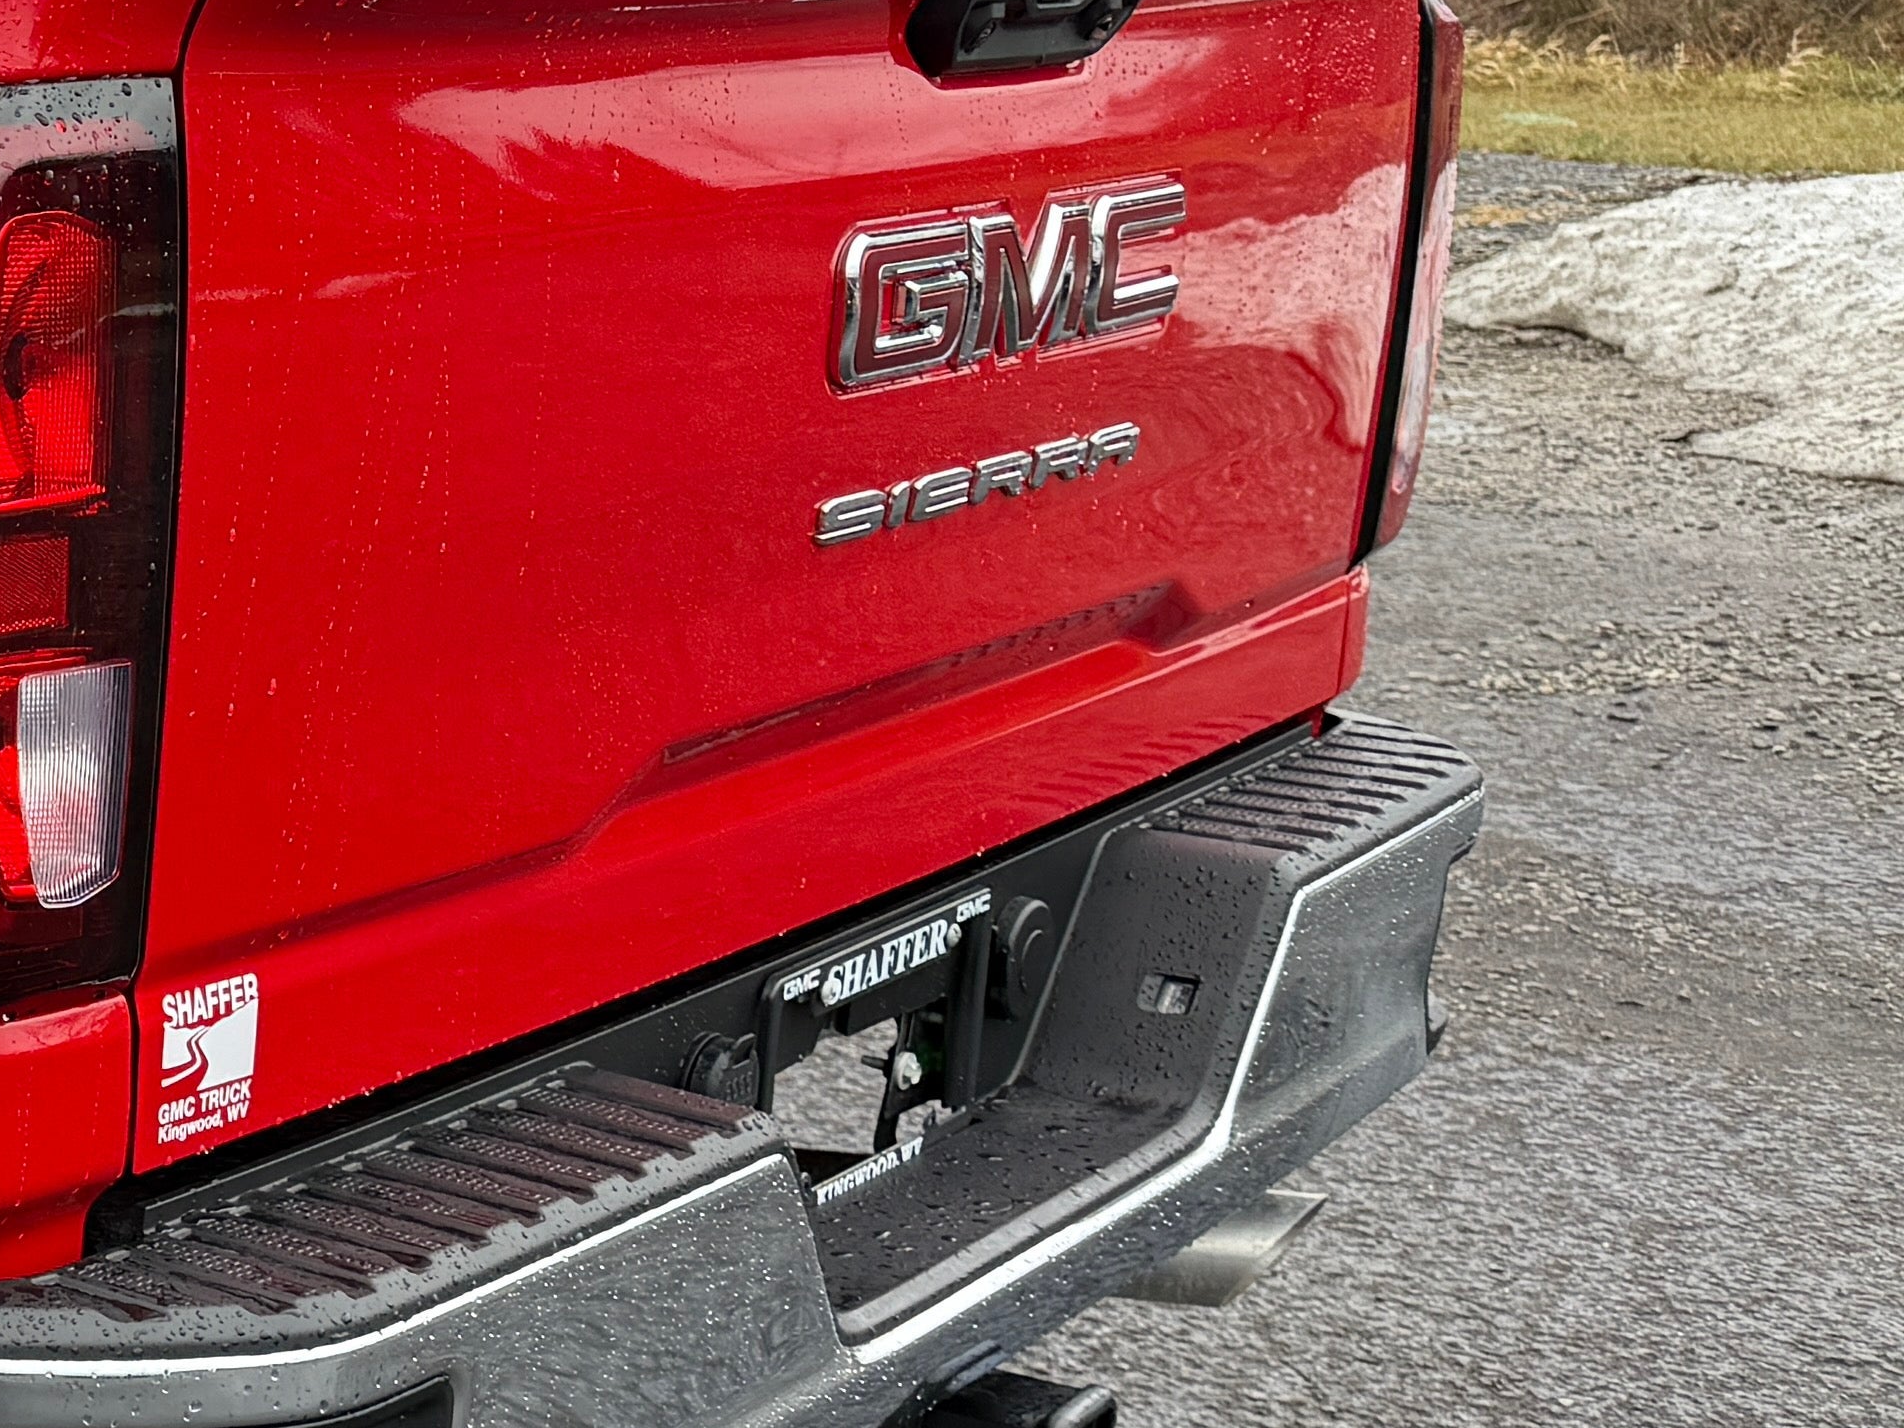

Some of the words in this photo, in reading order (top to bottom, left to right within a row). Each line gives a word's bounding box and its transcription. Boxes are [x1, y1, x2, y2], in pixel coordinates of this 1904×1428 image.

[832, 180, 1186, 389] GMC
[809, 421, 1141, 547] SIERRA
[783, 968, 822, 1001] GMC
[823, 918, 950, 1006] SHAFFER
[955, 893, 992, 923] GMC
[162, 973, 258, 1028] SHAFFER
[158, 1096, 195, 1123] GMC
[200, 1079, 252, 1112] TRUCK
[158, 1111, 223, 1144] Kingwood,
[227, 1100, 250, 1123] WV
